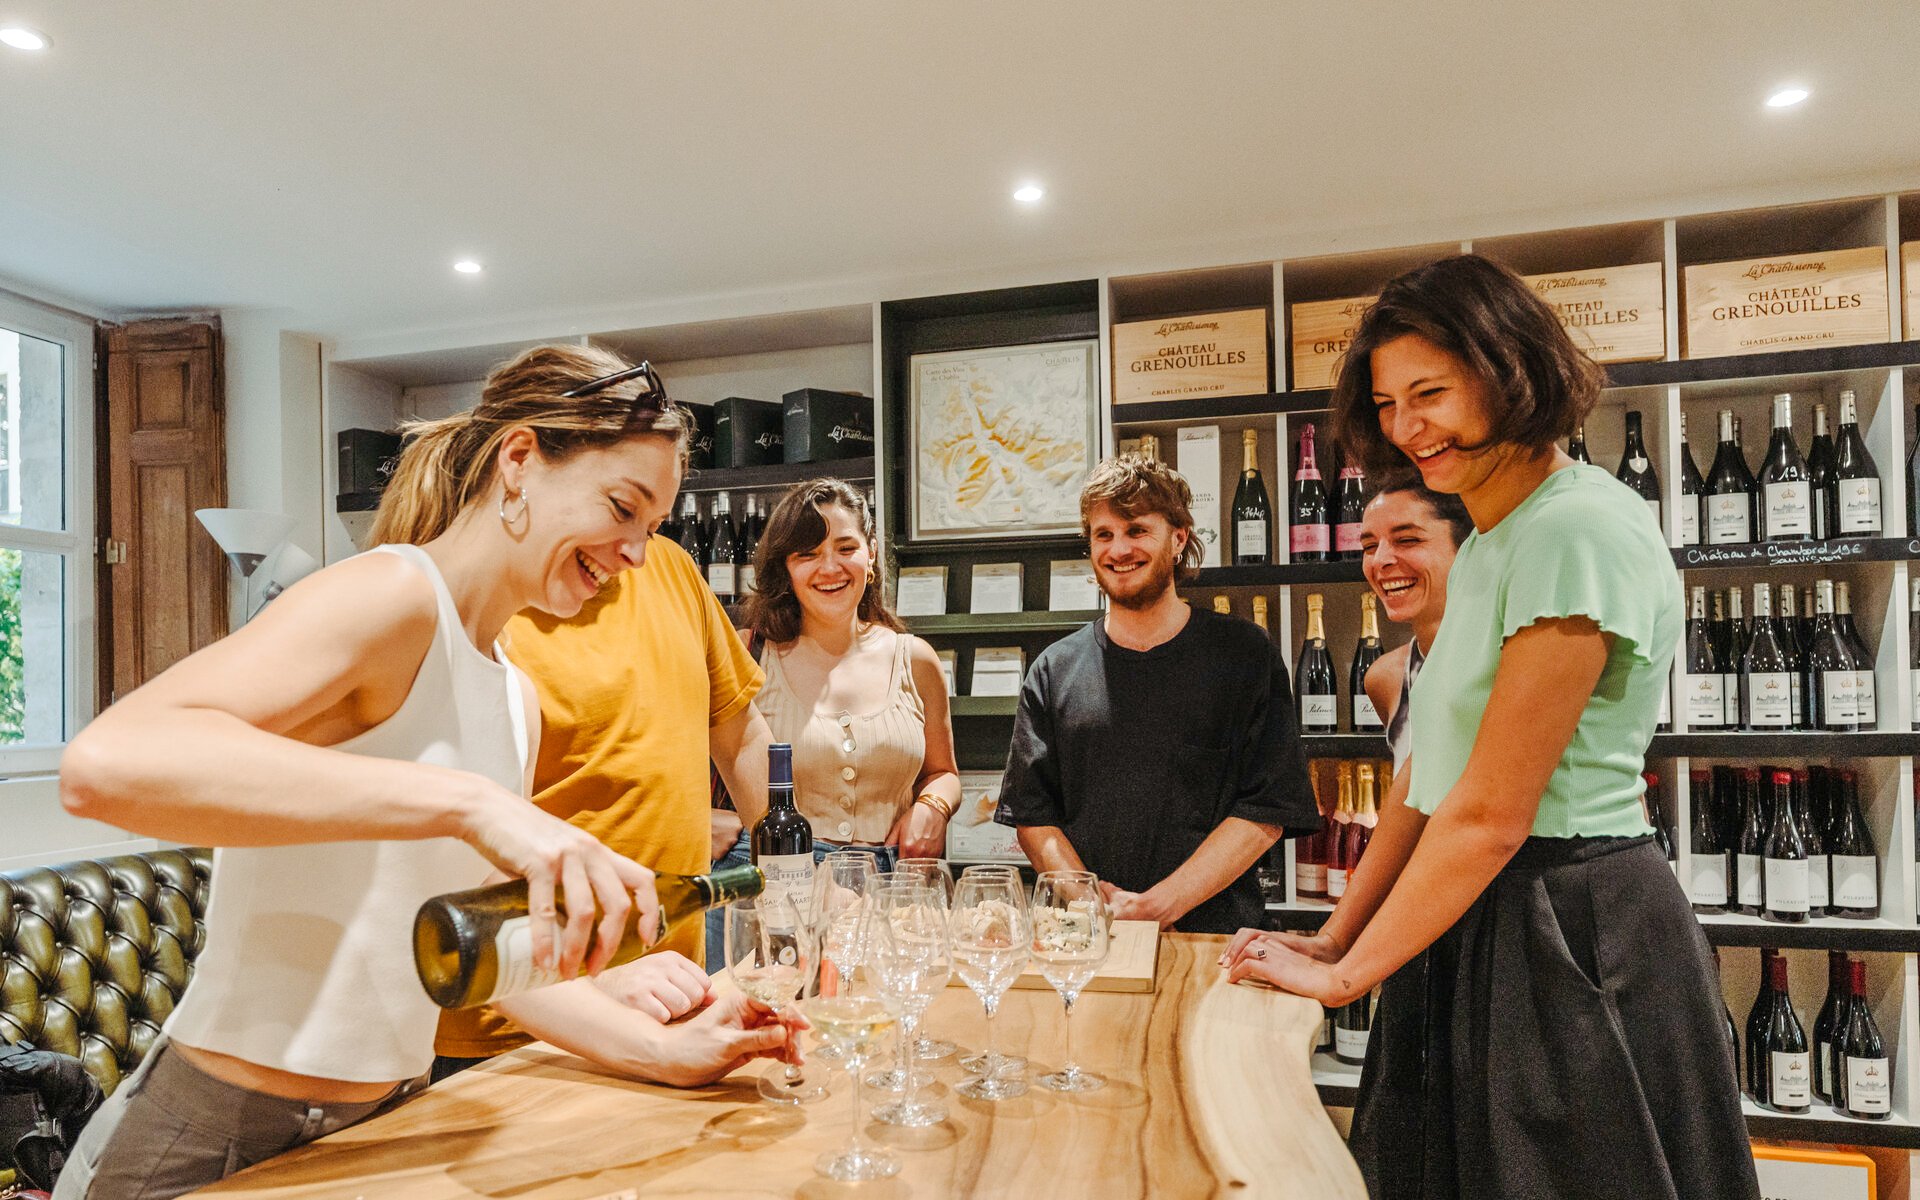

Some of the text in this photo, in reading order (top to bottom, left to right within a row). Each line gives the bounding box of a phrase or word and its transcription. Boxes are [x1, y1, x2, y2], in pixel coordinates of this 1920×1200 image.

[1748, 285, 1822, 303] CHÂTEAU
[1712, 293, 1861, 321] GRENOUILLES
[1560, 308, 1639, 328] OUILLES
[1740, 331, 1835, 347] CHABLIS GRAND CRU
[1158, 343, 1216, 357] CHÂTEAU
[1131, 350, 1246, 373] GRENOUILLES
[1183, 385, 1209, 394] GRAND
[1778, 466, 1798, 481] 19
